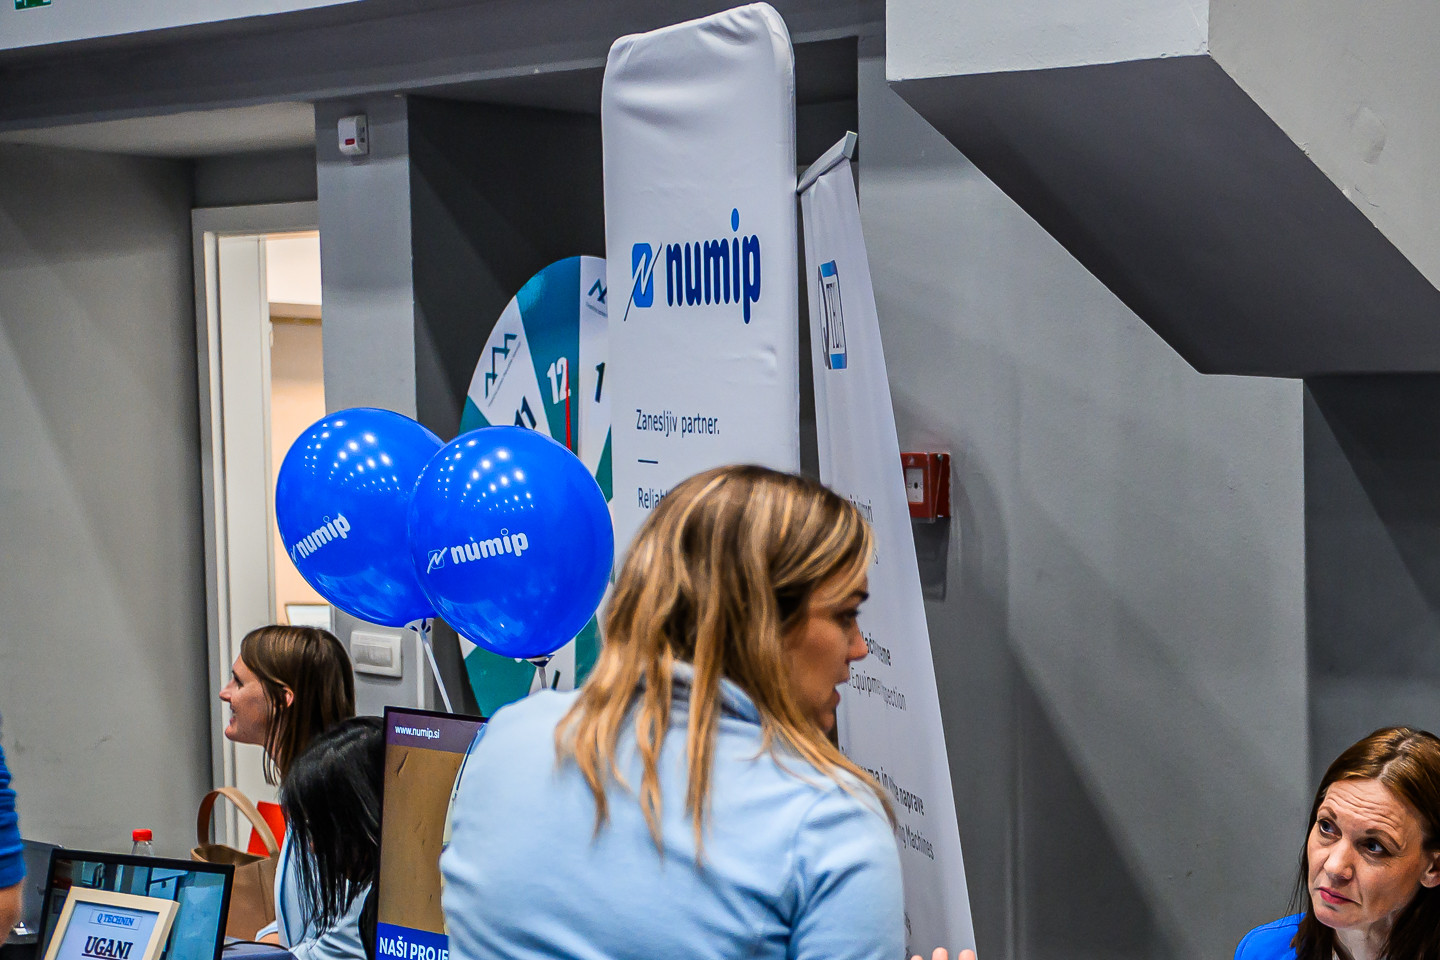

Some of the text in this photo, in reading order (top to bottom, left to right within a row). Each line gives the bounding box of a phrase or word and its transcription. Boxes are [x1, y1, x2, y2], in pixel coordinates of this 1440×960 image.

[666, 207, 761, 324] numip
[636, 409, 720, 439] Zanesljiv partner.
[295, 513, 351, 559] numip
[450, 528, 529, 564] numip
[394, 725, 440, 740] www.numip.si
[84, 936, 133, 960] UGANI
[379, 935, 408, 960] NAŠI
